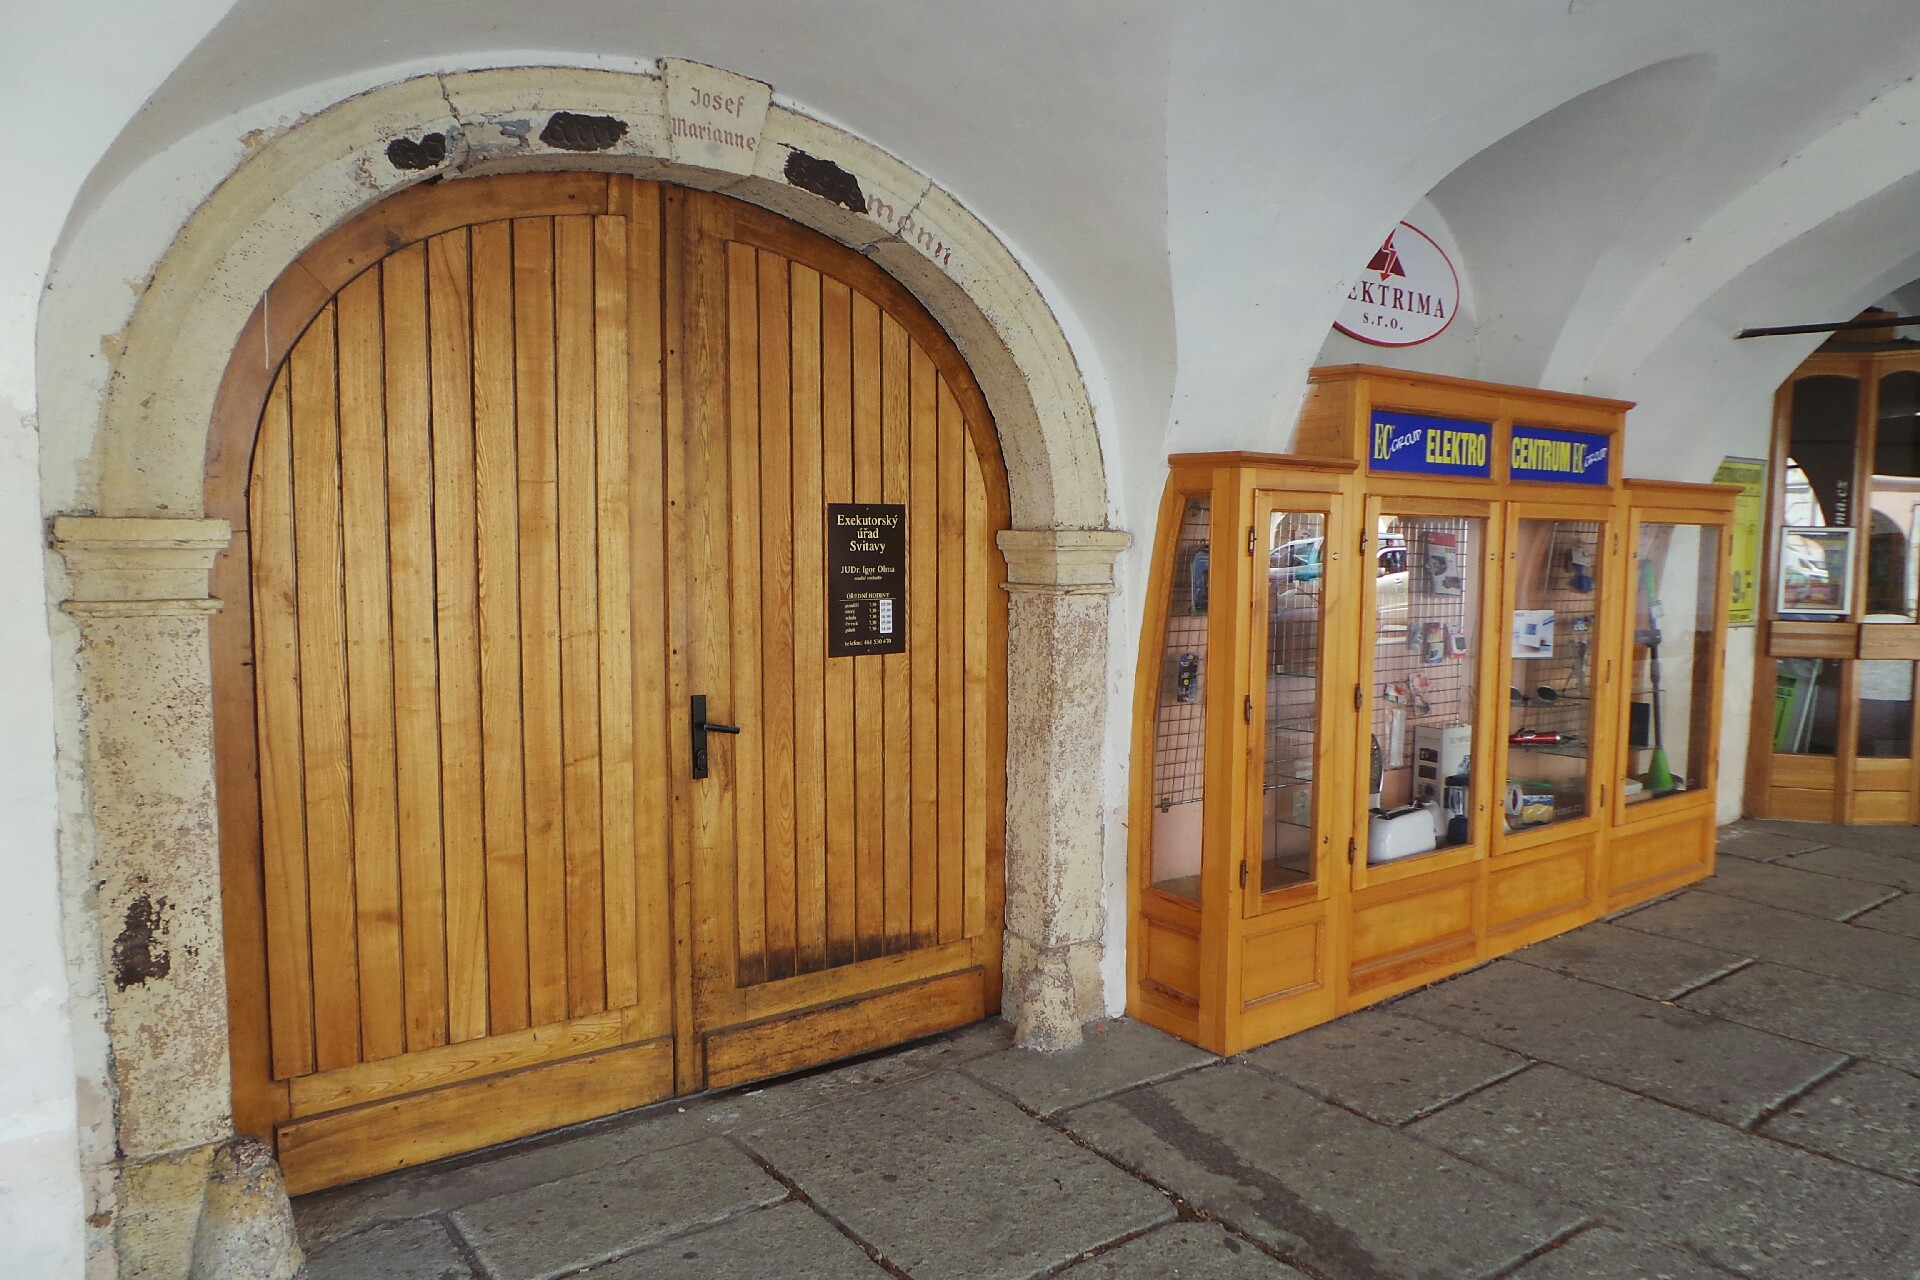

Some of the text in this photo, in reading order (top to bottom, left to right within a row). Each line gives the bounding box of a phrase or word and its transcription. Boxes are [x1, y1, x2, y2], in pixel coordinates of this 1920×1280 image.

[690, 86, 745, 119] Josef
[671, 116, 756, 152] Marianne
[1362, 312, 1404, 331] s.r.o.
[1426, 428, 1487, 467] ELEKTRO
[1511, 436, 1572, 473] CENTRUM
[836, 514, 898, 529] Exekutorský
[857, 527, 880, 540] úřad
[849, 540, 886, 554] Svitavy
[840, 565, 861, 574] JUDr.
[862, 565, 876, 576] Igor
